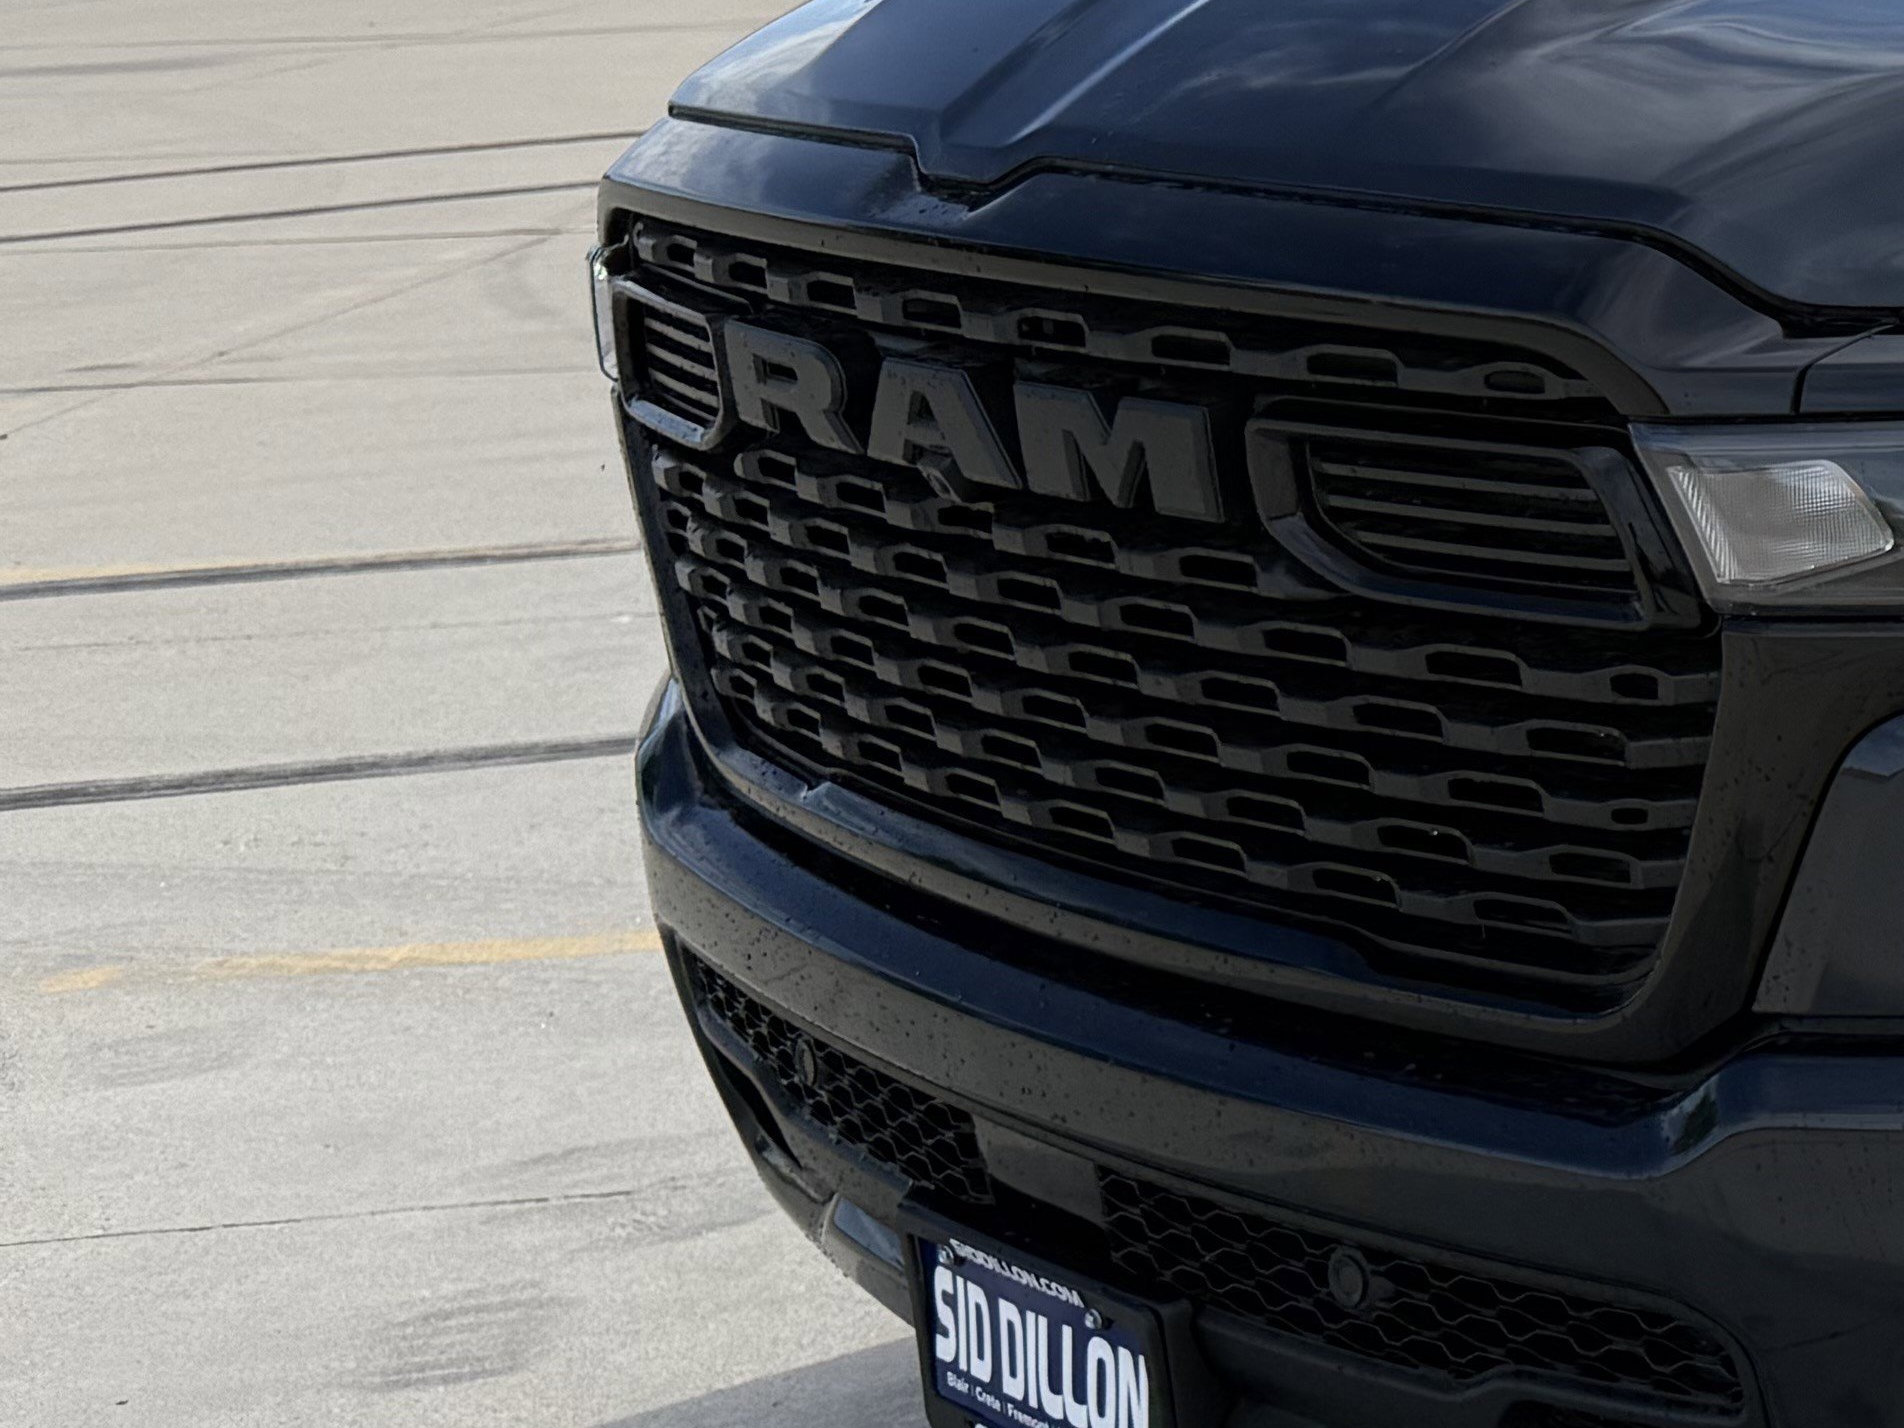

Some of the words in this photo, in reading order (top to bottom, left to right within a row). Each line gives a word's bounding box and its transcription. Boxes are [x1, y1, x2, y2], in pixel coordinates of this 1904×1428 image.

[725, 319, 1226, 523] RAM
[933, 1265, 992, 1384] SID
[946, 1371, 969, 1394] Blair
